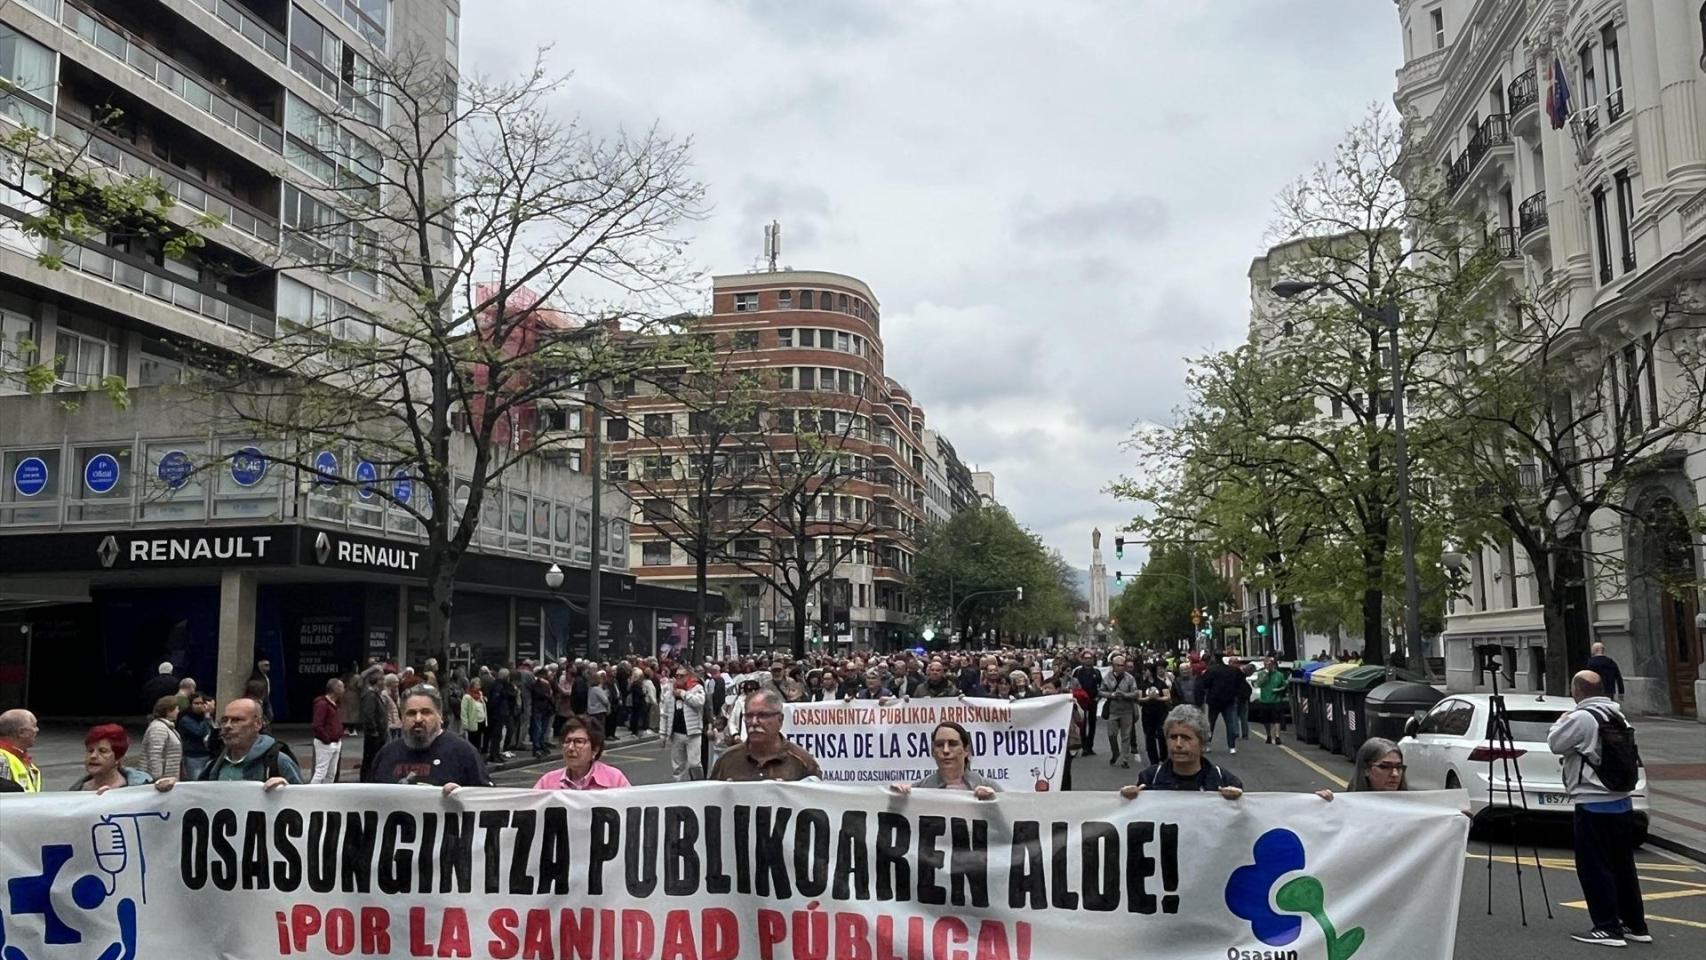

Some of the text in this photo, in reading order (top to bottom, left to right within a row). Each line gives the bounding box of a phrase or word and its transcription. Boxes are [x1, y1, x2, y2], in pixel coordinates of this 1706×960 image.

[130, 536, 272, 561] RENAULT
[337, 541, 420, 571] RENAULT
[300, 624, 334, 634] ALPINE
[300, 635, 335, 645] BILBAO
[298, 664, 339, 673] ENEKURI
[793, 705, 1012, 726] OSASUNGINTZA PUBLIKOA ARRISKUAN!
[854, 732, 874, 759] DE
[880, 732, 901, 758] LA
[857, 769, 921, 782] OSASUNGINTZA
[987, 768, 1009, 780] ALDE
[181, 806, 1180, 914] OSASUNGINTZA PUBLIKOAREN ALDE!
[276, 900, 1032, 960] ¡POR LA SANIDAD PÚBLICA!
[1227, 947, 1298, 960] Osasun
